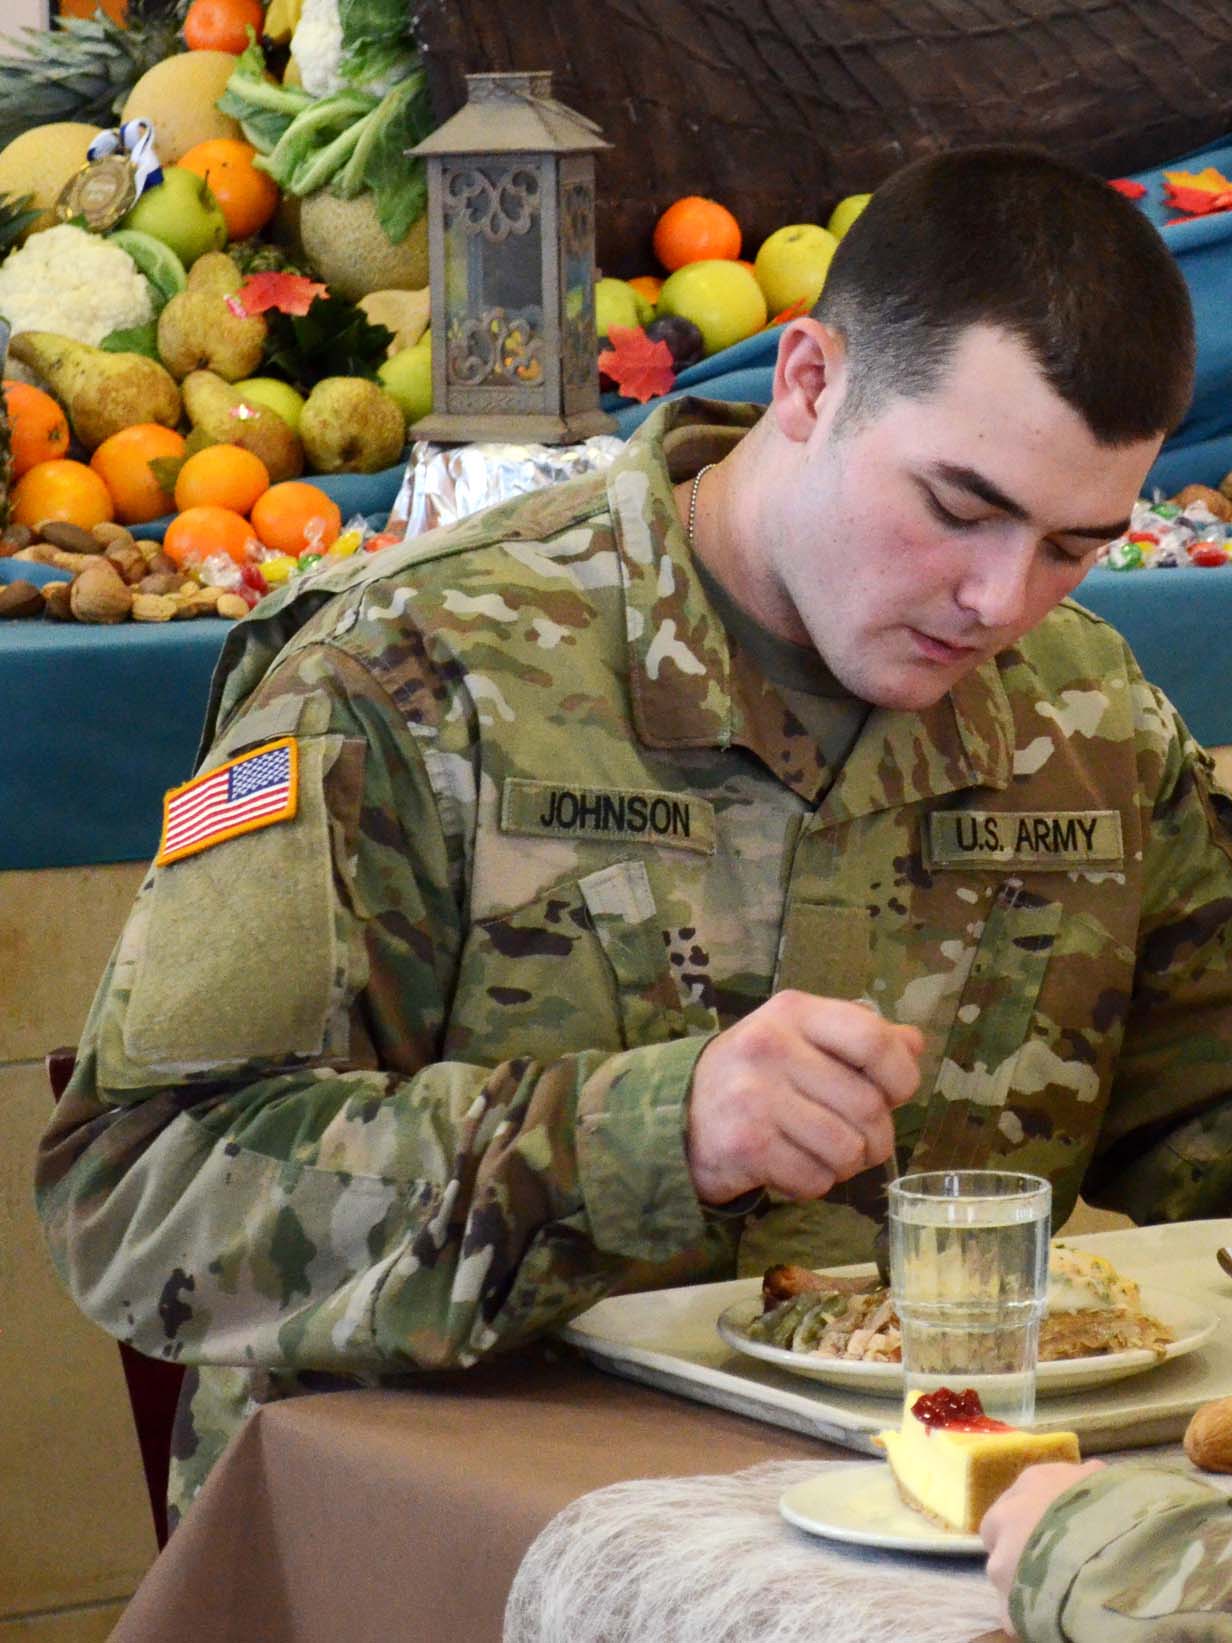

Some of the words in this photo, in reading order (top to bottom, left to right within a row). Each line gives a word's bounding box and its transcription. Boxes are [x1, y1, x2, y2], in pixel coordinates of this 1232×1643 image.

[540, 790, 691, 838] JOHNSON
[956, 817, 1005, 852] U.S.
[1014, 817, 1098, 853] ARMY
